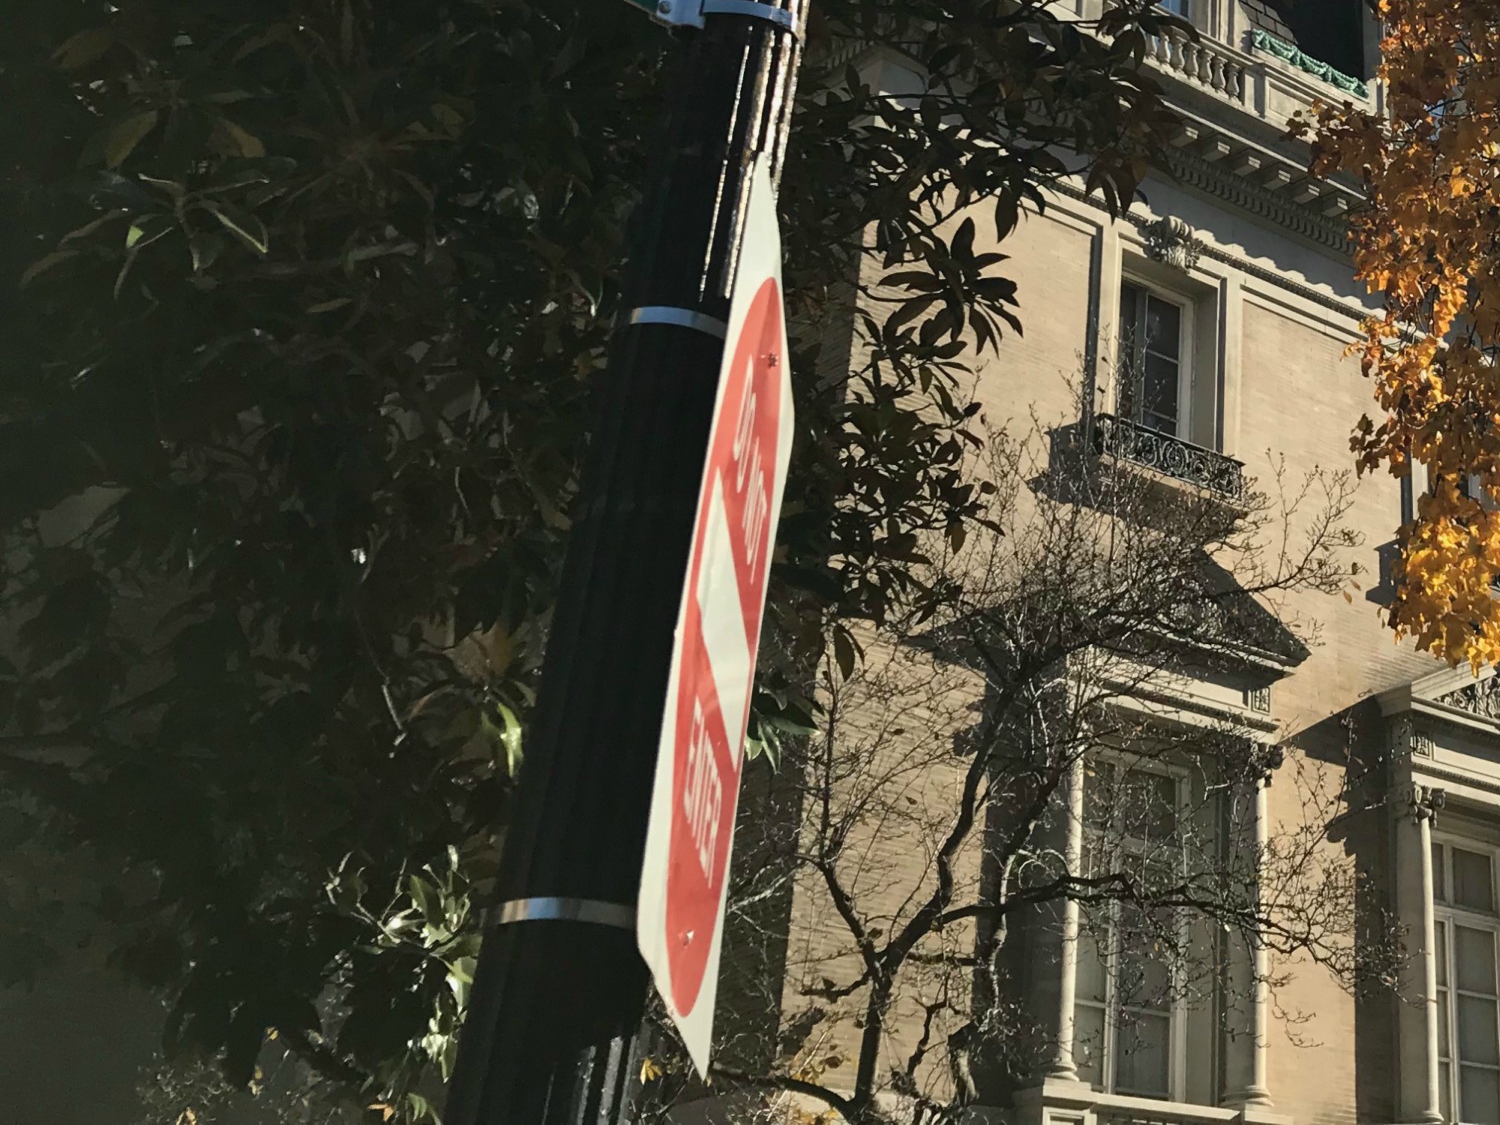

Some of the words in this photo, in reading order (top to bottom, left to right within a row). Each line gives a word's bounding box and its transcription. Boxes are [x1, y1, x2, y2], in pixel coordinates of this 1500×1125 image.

[733, 354, 756, 494] DO
[742, 436, 767, 585] NOT
[684, 695, 722, 889] ENTER
